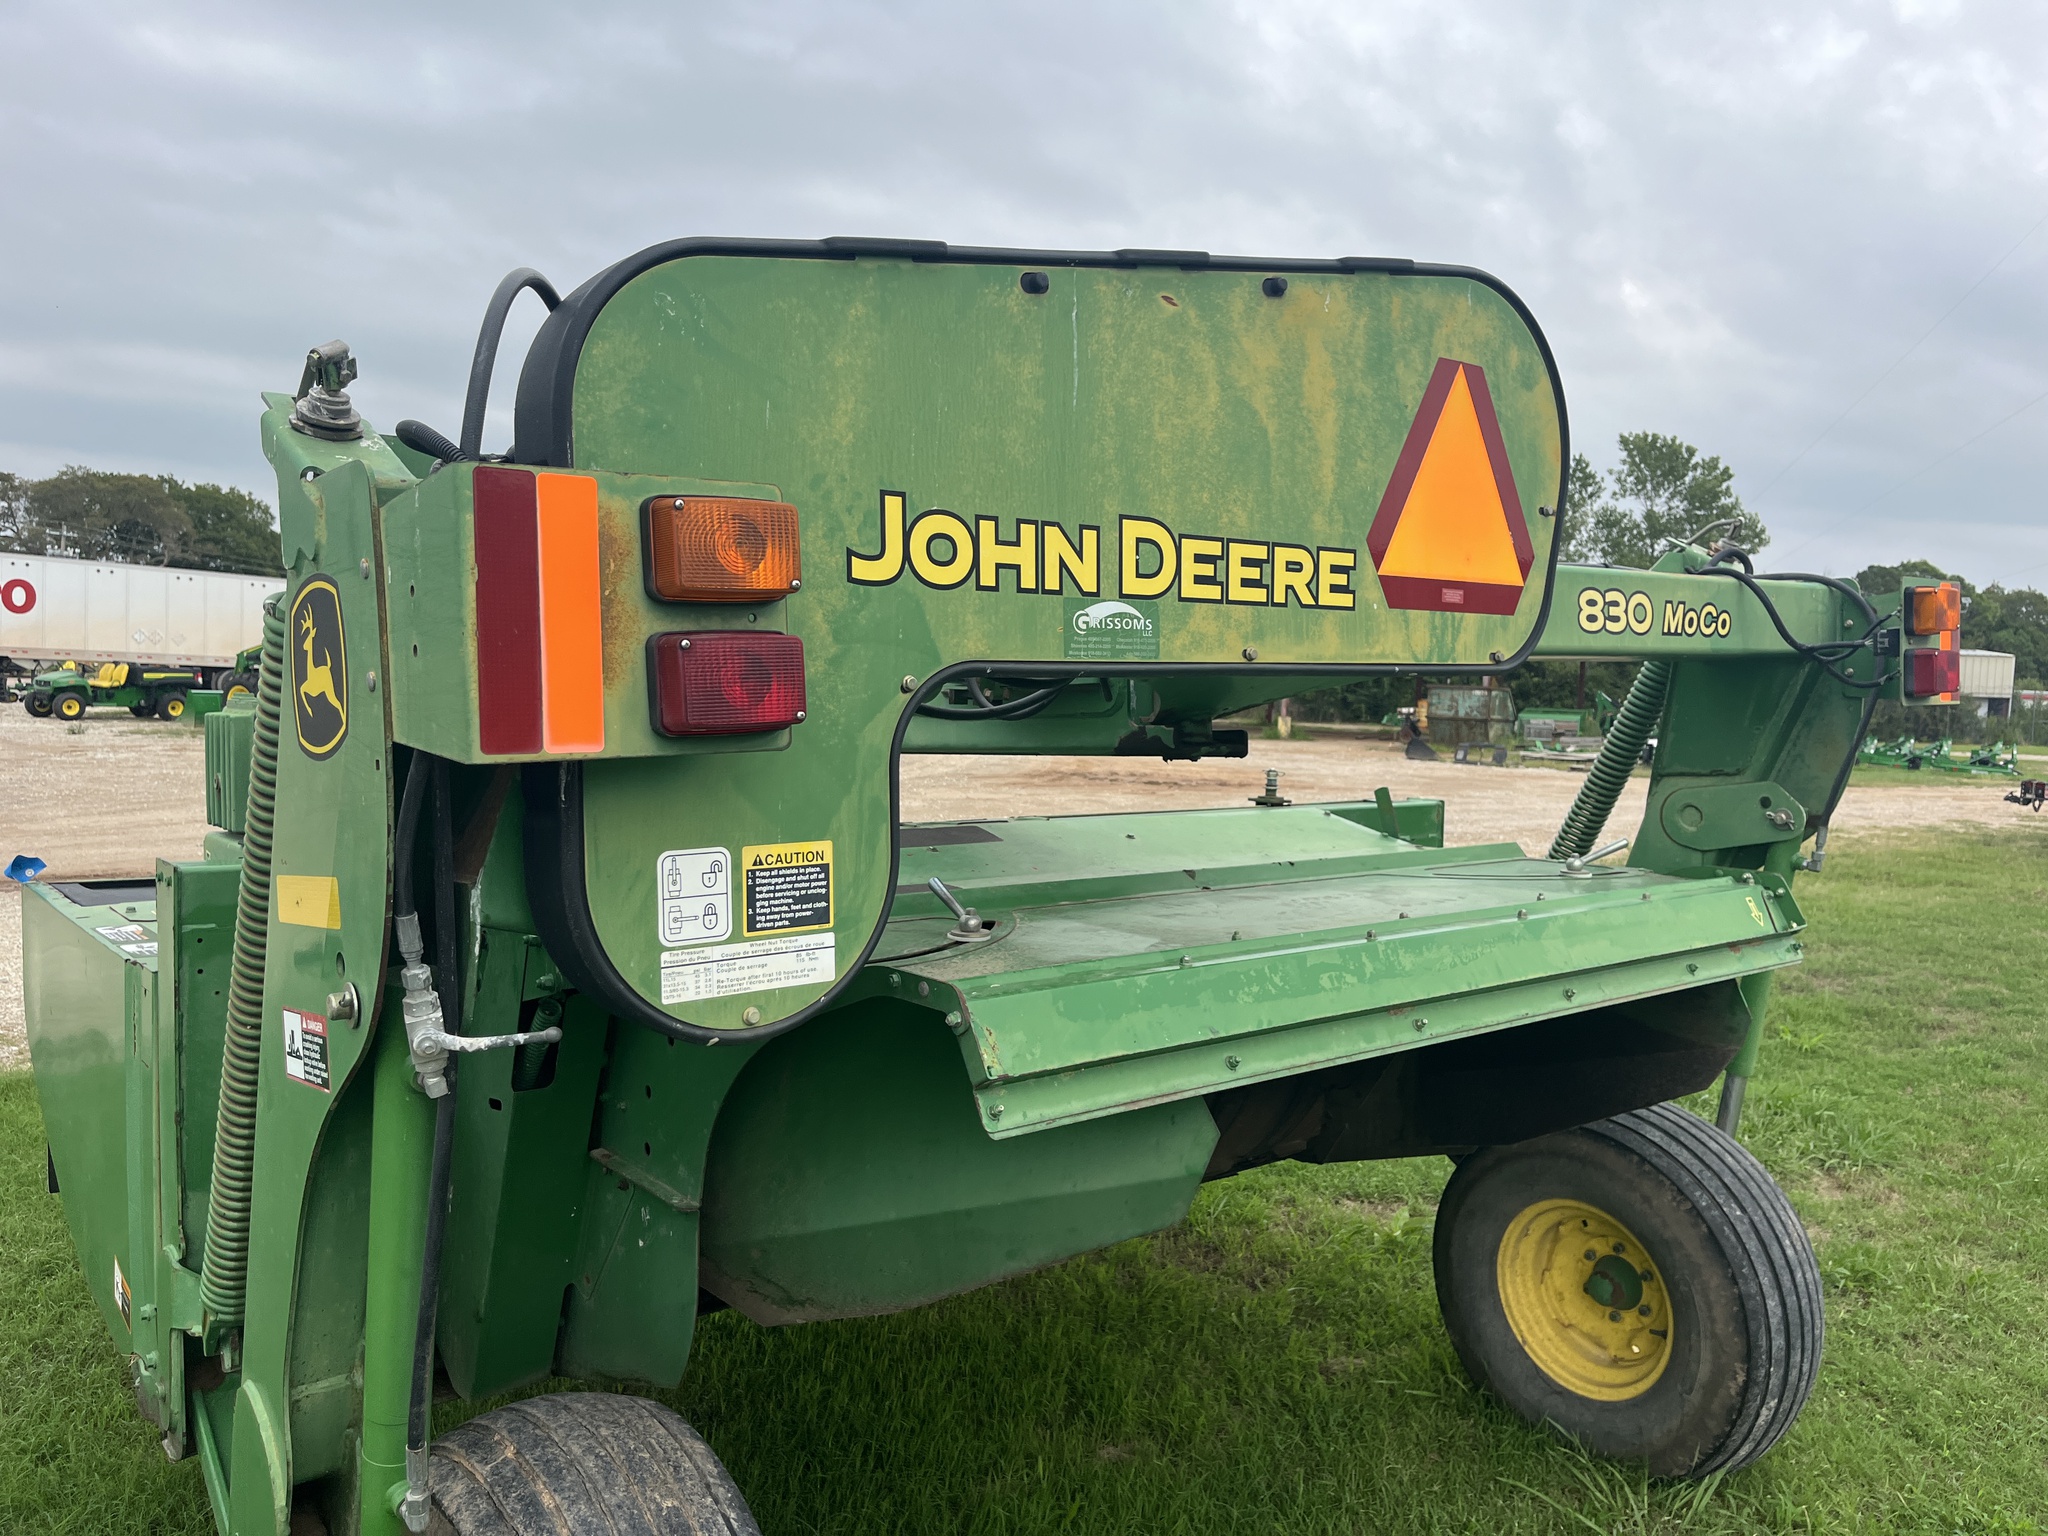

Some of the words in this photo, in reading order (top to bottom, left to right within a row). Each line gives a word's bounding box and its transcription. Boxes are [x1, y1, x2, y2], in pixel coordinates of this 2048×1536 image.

[846, 489, 1101, 598] JOHN
[1119, 514, 1357, 611] DEERE
[1073, 610, 1153, 635] GRISSOMS
[1578, 587, 1654, 635] 830
[1662, 600, 1731, 639] MoCo
[765, 850, 824, 865] CAUTION
[811, 881, 827, 889] power
[716, 976, 746, 984] Re-Torque
